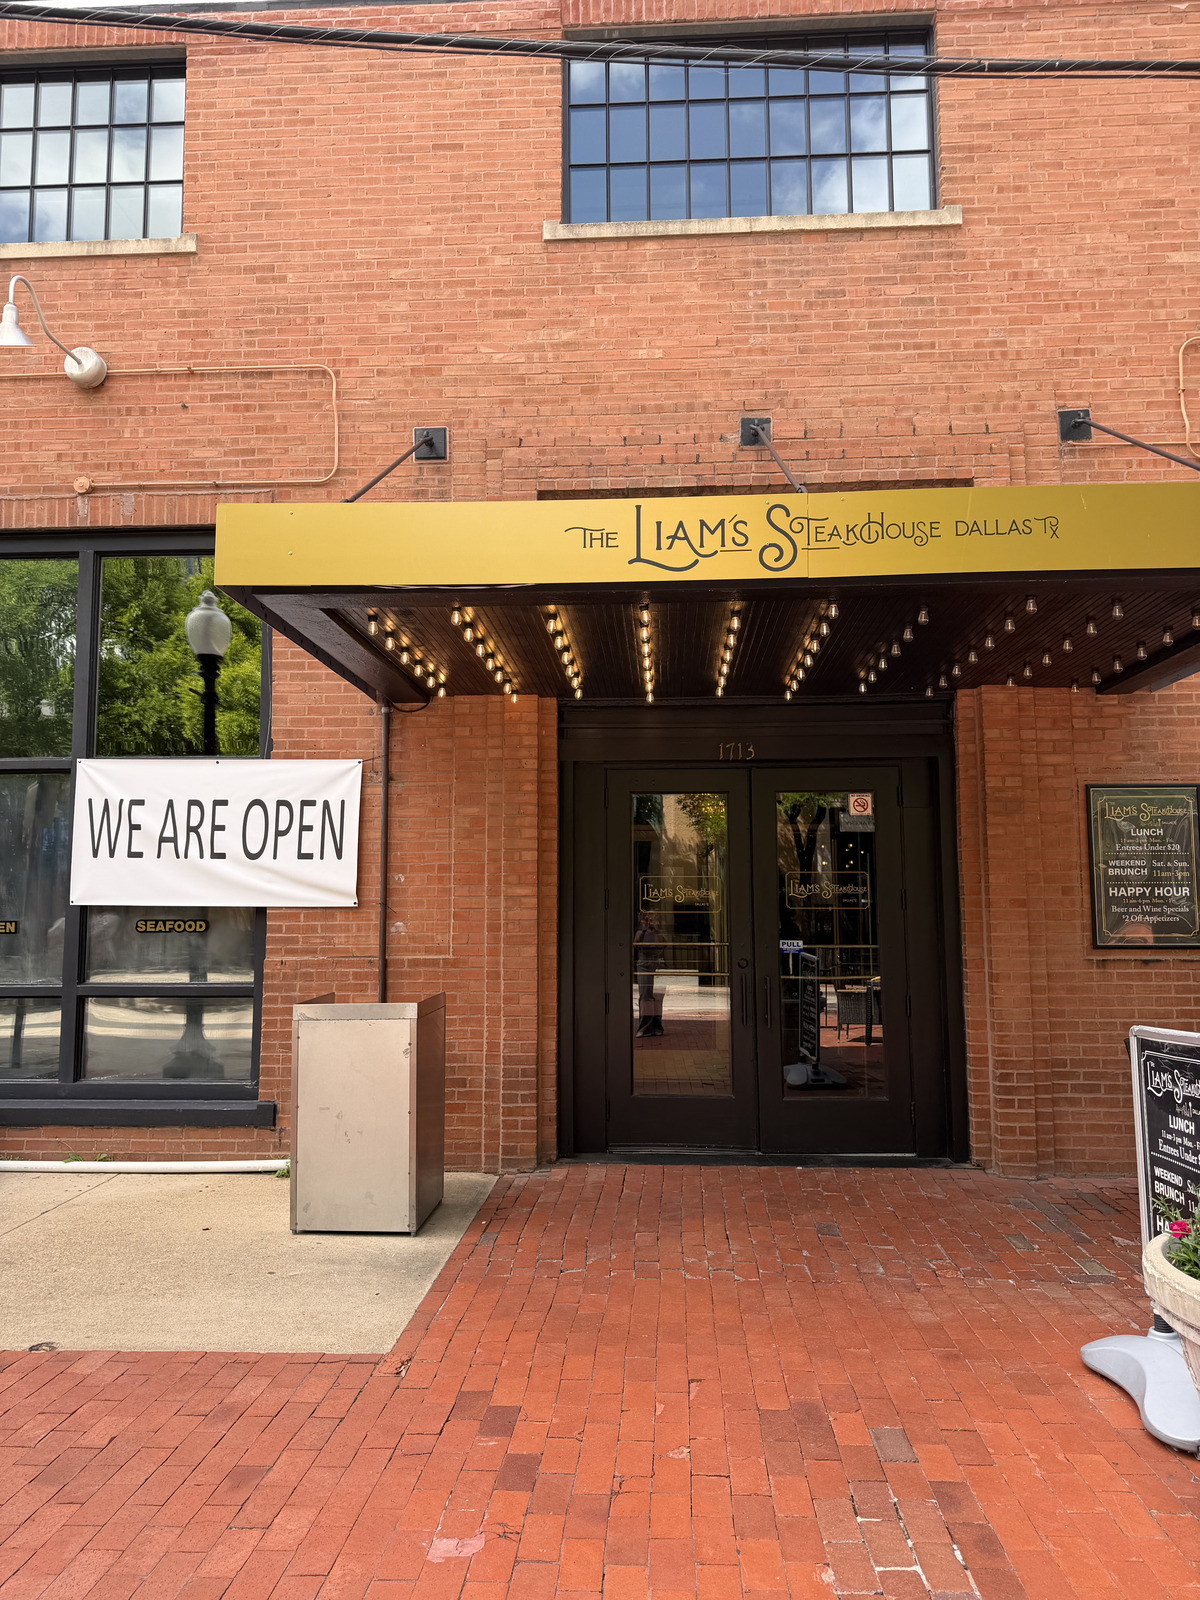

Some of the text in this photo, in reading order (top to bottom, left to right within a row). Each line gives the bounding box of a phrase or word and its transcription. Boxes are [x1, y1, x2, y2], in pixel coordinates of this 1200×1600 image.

[758, 503, 942, 572] STEAKHOUSE
[954, 518, 1033, 537] DALLAS
[719, 742, 755, 760] 1713
[87, 797, 346, 861] WE ARE OPEN
[1130, 828, 1164, 836] LUNCH
[1115, 843, 1180, 851] Entrees Under $20
[1152, 859, 1166, 867] Sat.
[1173, 859, 1190, 867] Sun.
[1108, 868, 1148, 876] BRUNCH
[1152, 869, 1190, 878] 11am-3pm
[1108, 886, 1190, 897] HAPPY HOUR
[1111, 905, 1189, 914] Beer and Wine Specials
[1143, 914, 1180, 924] Appetizers
[136, 920, 206, 932] SEAFOOD
[1168, 1114, 1195, 1135] LUNCH
[1158, 1138, 1180, 1158] Entrees
[1179, 1145, 1198, 1165] Under
[1153, 1165, 1183, 1187] WEEKEND
[1154, 1180, 1186, 1206] BRUNCH
